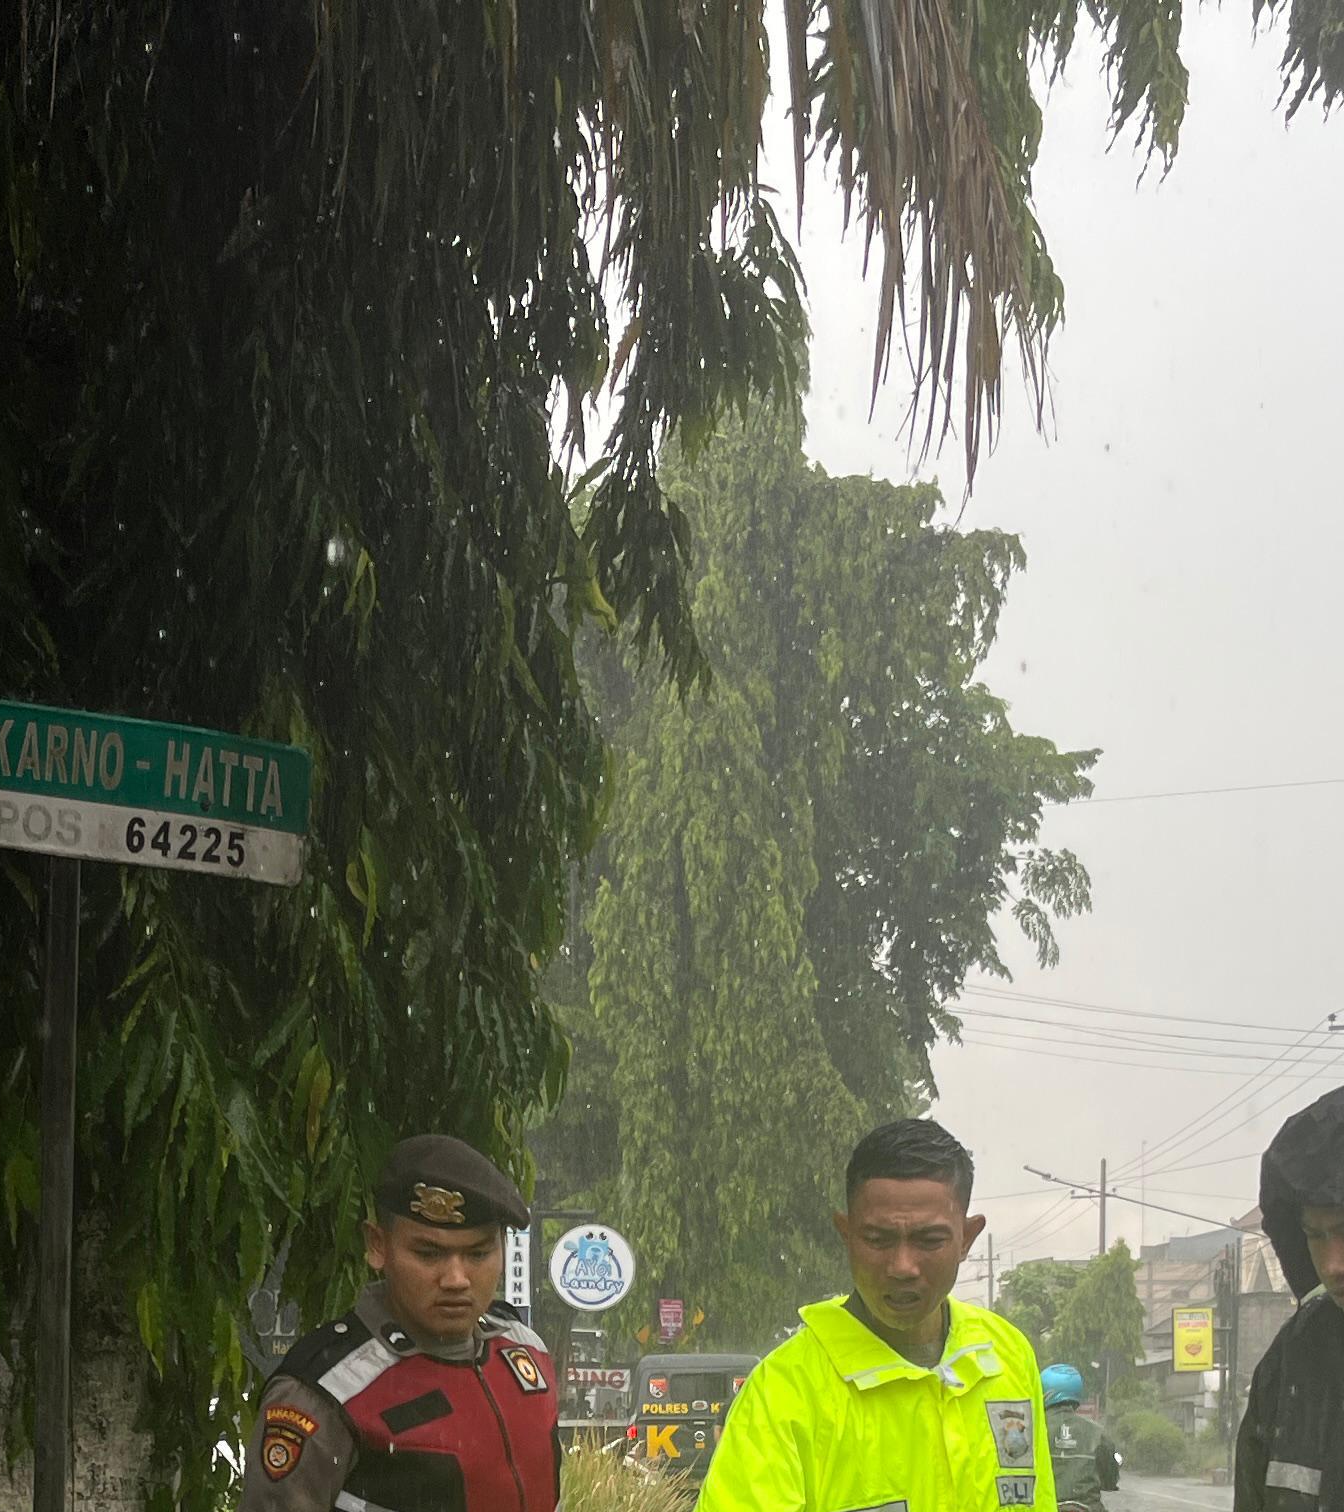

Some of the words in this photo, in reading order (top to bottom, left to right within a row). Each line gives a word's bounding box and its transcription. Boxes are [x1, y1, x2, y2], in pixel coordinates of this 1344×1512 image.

[125, 816, 246, 868] 64225
[560, 1276, 625, 1295] Laundry
[642, 1402, 689, 1415] POLRES
